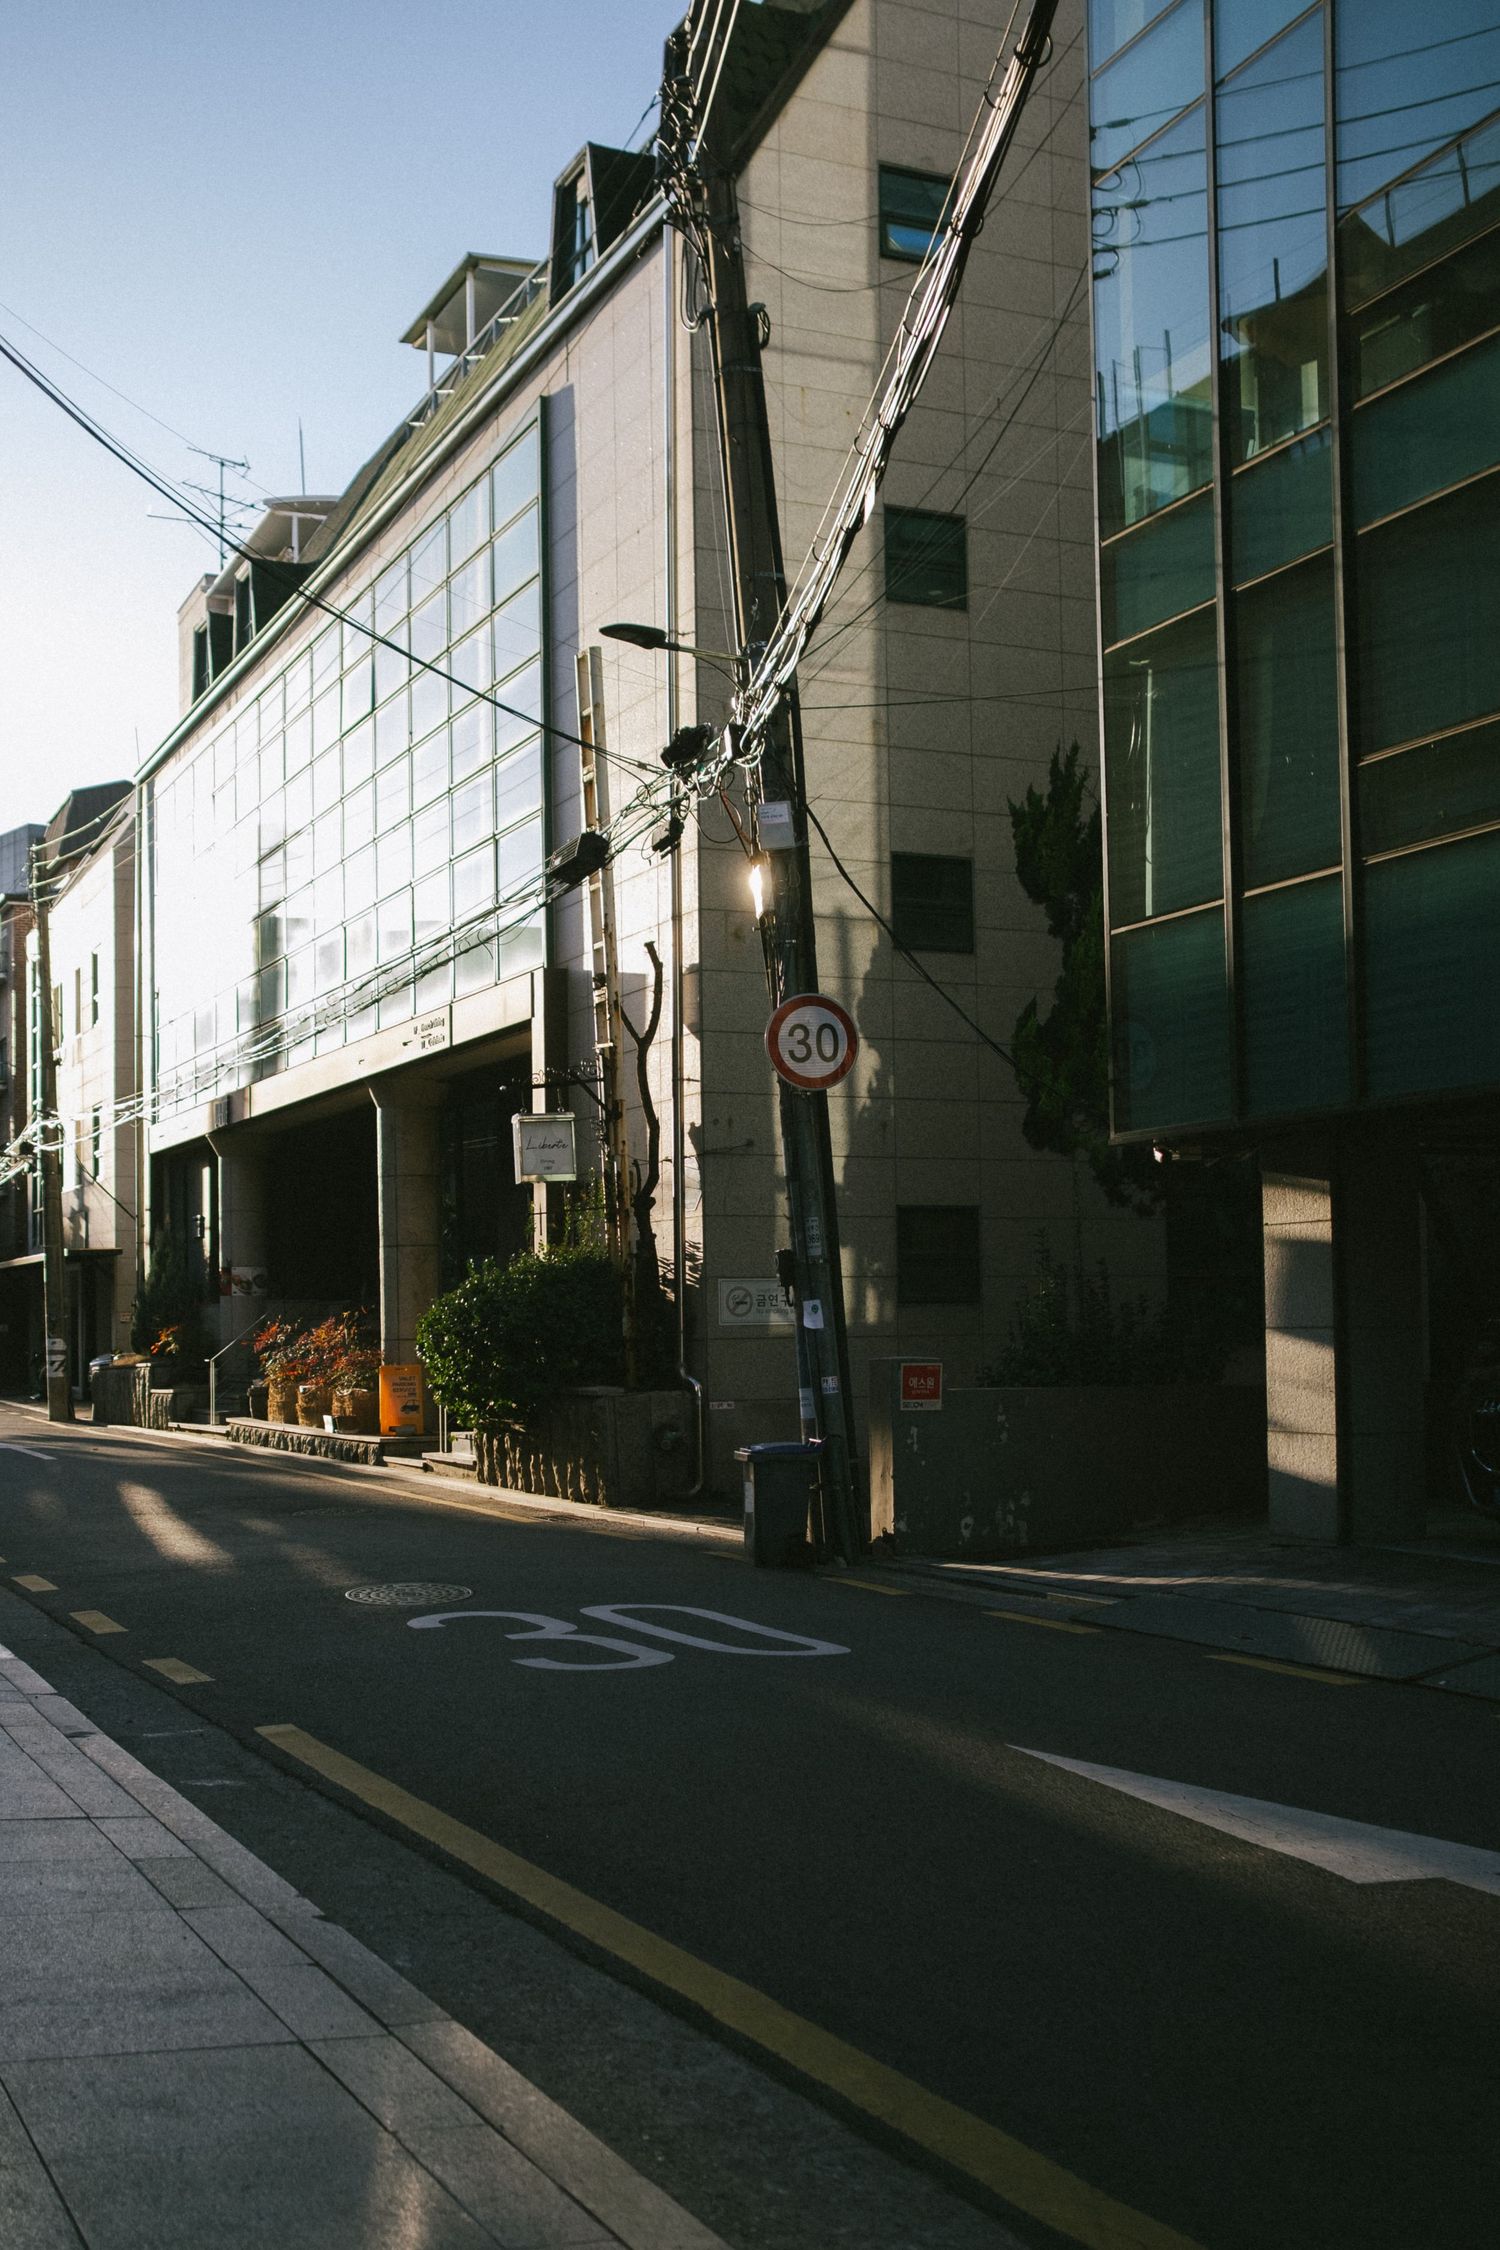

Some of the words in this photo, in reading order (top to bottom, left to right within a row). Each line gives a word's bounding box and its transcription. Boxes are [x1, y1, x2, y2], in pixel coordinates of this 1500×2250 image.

[788, 1023, 839, 1063] 30
[909, 1376, 935, 1389] 에스원
[407, 1603, 852, 1671] 30
